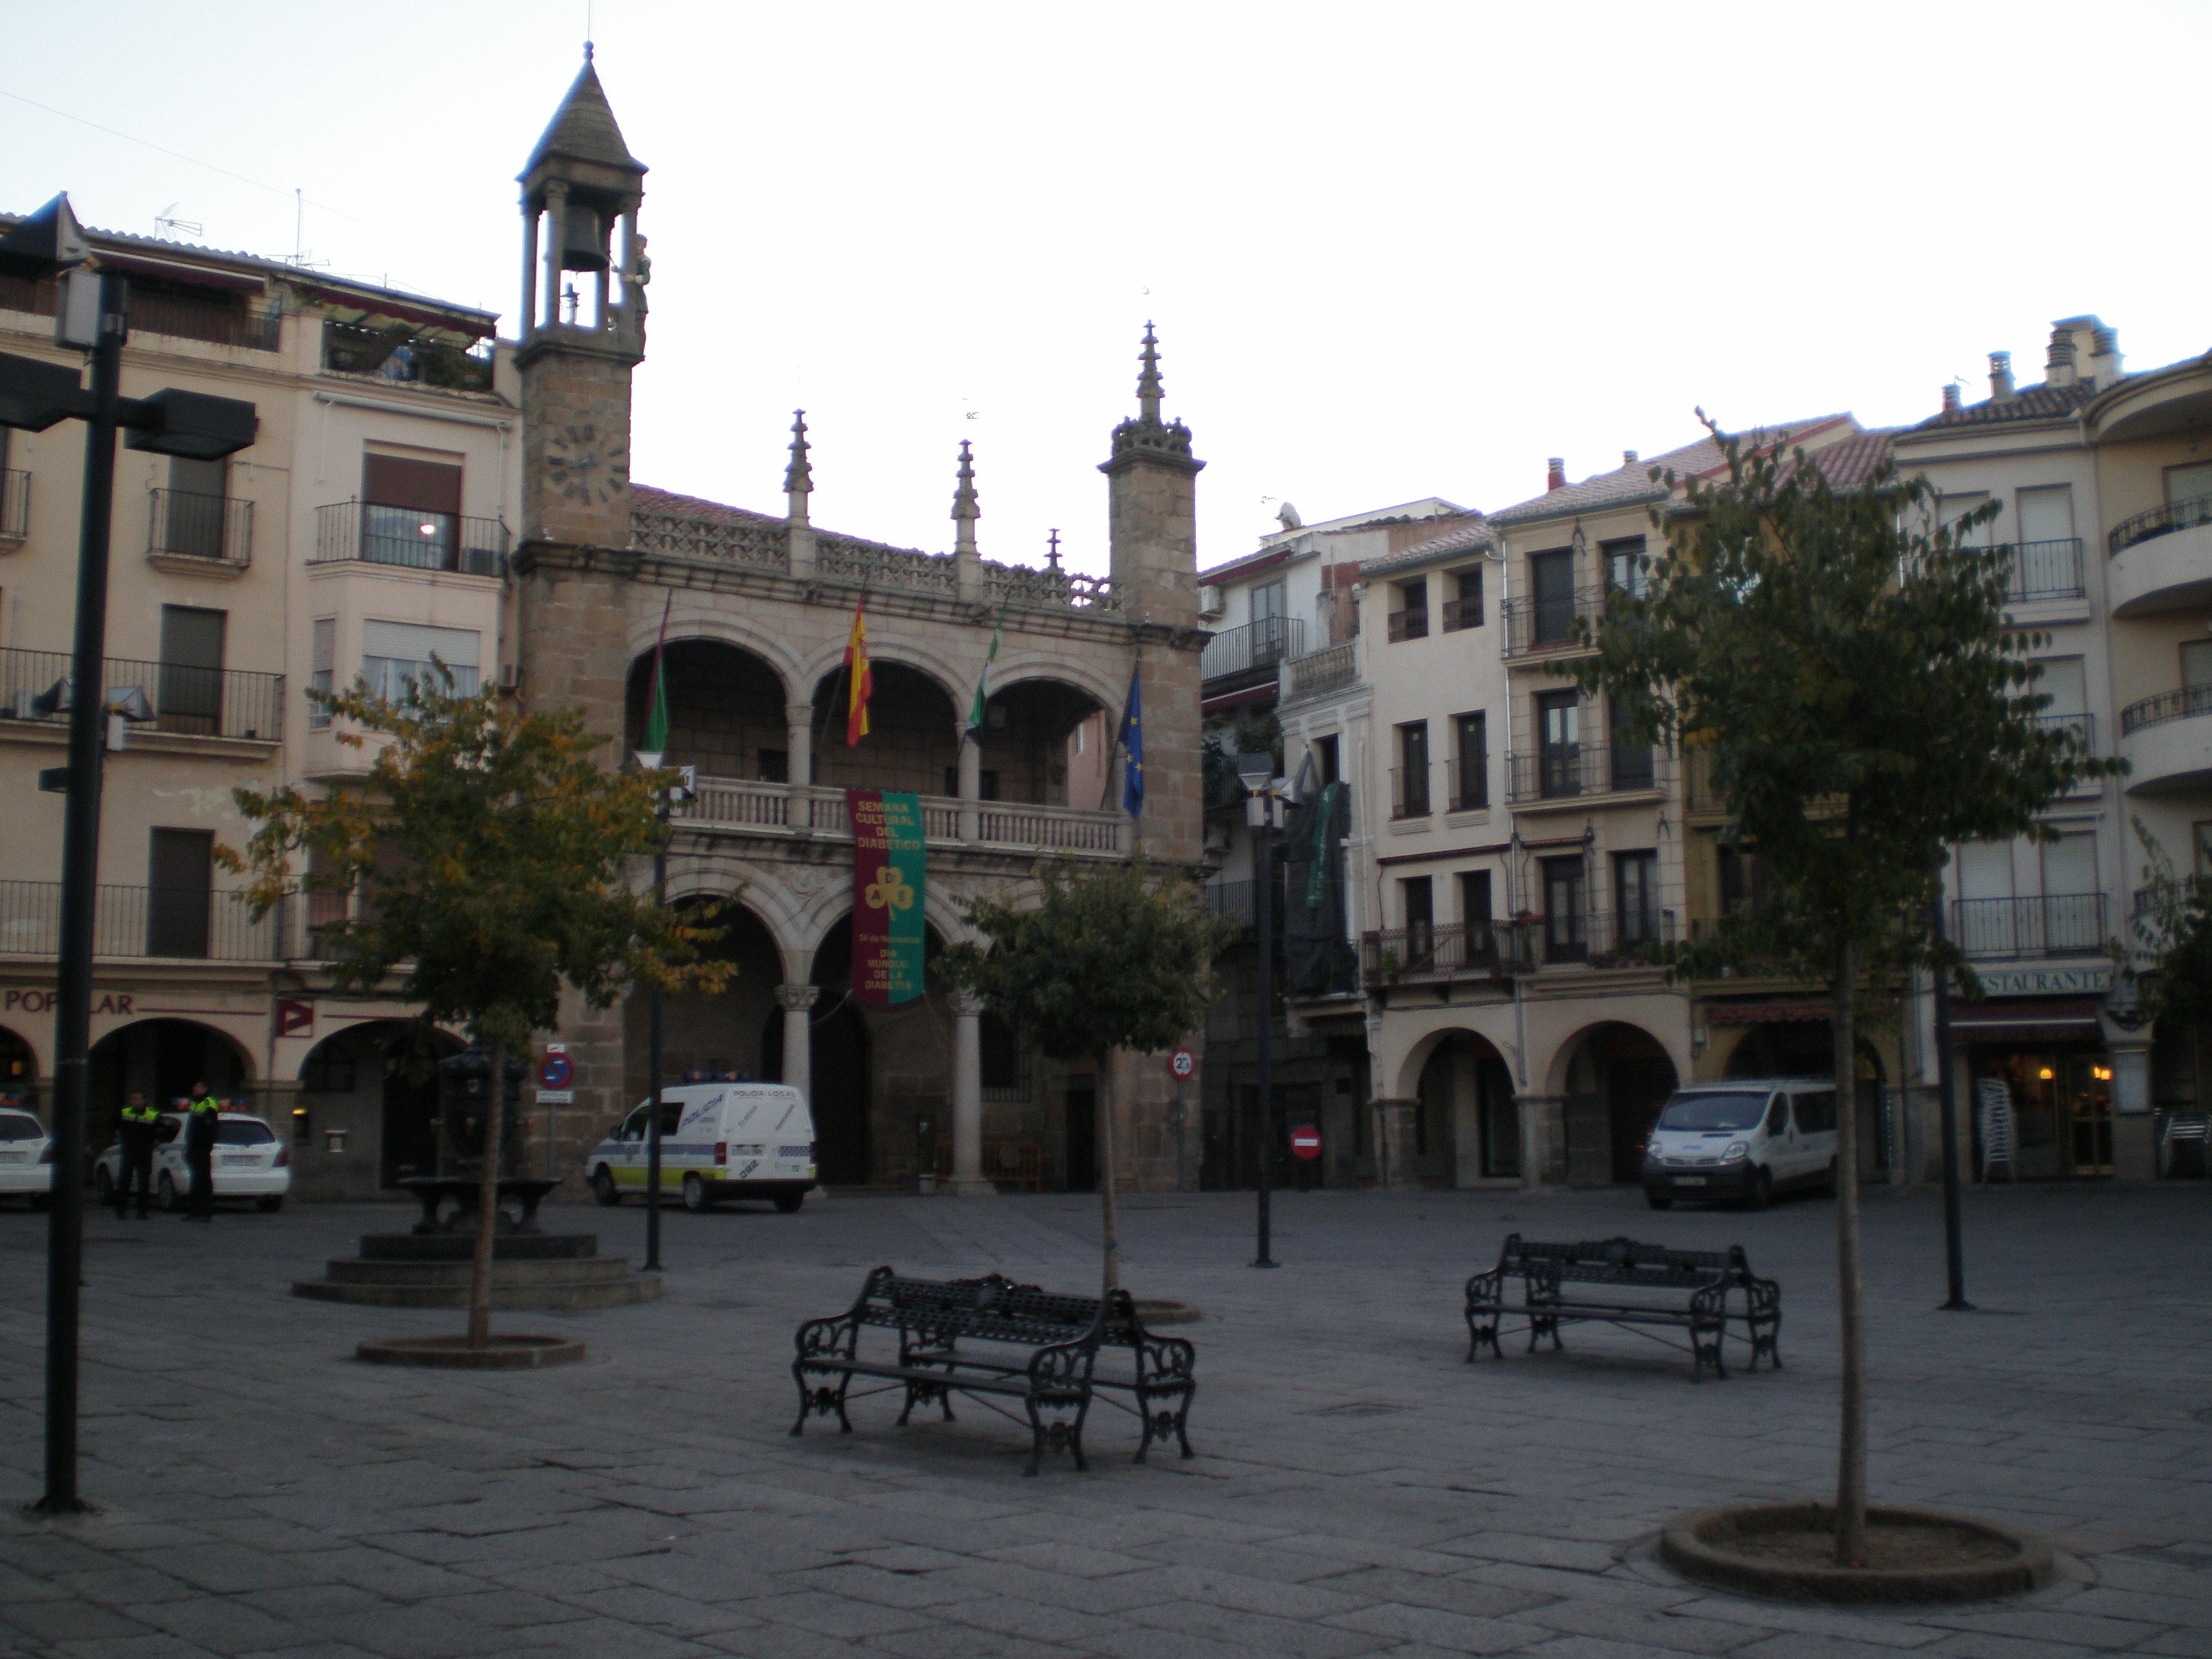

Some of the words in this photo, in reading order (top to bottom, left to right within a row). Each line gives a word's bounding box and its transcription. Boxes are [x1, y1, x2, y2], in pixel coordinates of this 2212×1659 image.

[858, 801, 909, 813] SEMANA
[855, 812, 915, 825] CULTURAL
[876, 827, 896, 837] DEL
[885, 872, 894, 884] D
[871, 889, 881, 901] A
[867, 959, 909, 968] MUNDIAL
[874, 970, 887, 979] DE
[889, 971, 902, 979] LA
[865, 980, 911, 989] DIABETES
[1980, 972, 2108, 992] STAURANTE
[6, 990, 132, 1015] POPAR
[682, 1093, 724, 1129] POLICIA
[739, 1159, 759, 1179] 092
